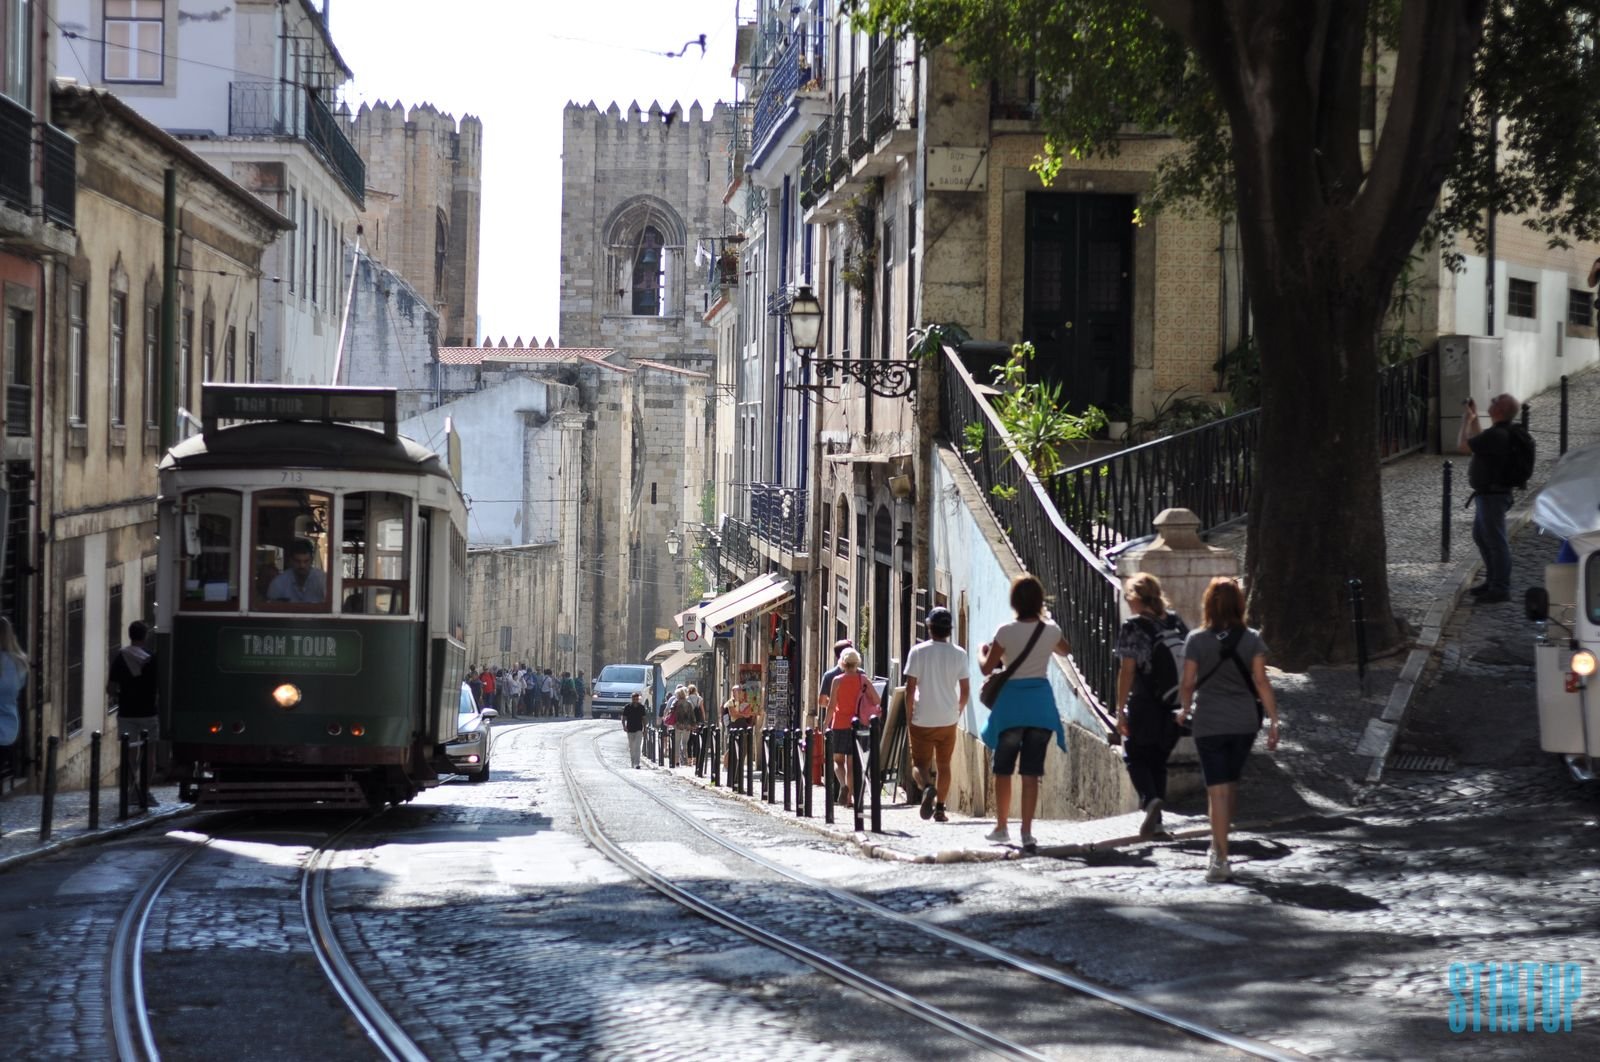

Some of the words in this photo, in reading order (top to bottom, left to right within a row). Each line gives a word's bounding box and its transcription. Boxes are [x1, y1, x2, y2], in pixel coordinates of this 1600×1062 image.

[234, 397, 266, 412] TRAM
[271, 398, 304, 413] TOUR
[281, 471, 303, 482] 713
[242, 634, 286, 656] TRAM
[291, 635, 336, 657] TOUR
